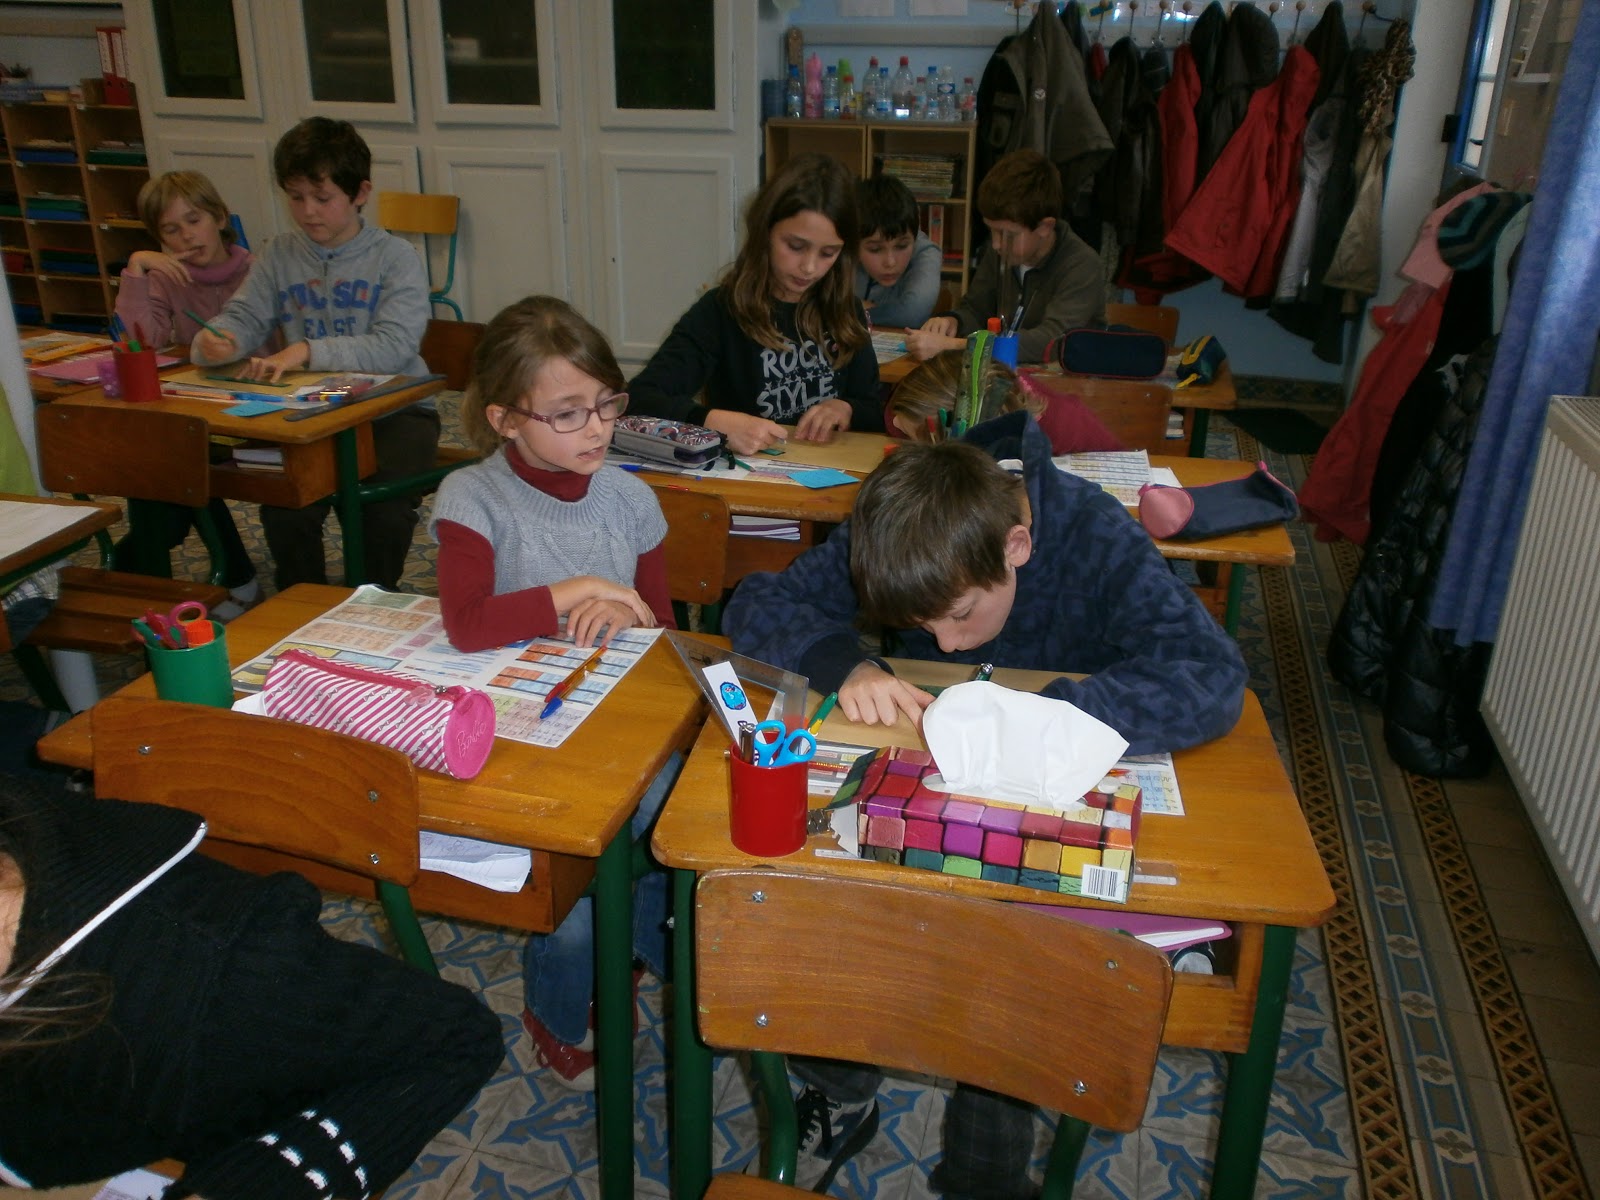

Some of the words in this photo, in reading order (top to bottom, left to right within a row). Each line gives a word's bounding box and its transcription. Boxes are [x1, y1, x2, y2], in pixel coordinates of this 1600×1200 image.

[304, 316, 356, 338] EAST
[756, 375, 838, 418] STYLE
[456, 719, 487, 757] Barbie
